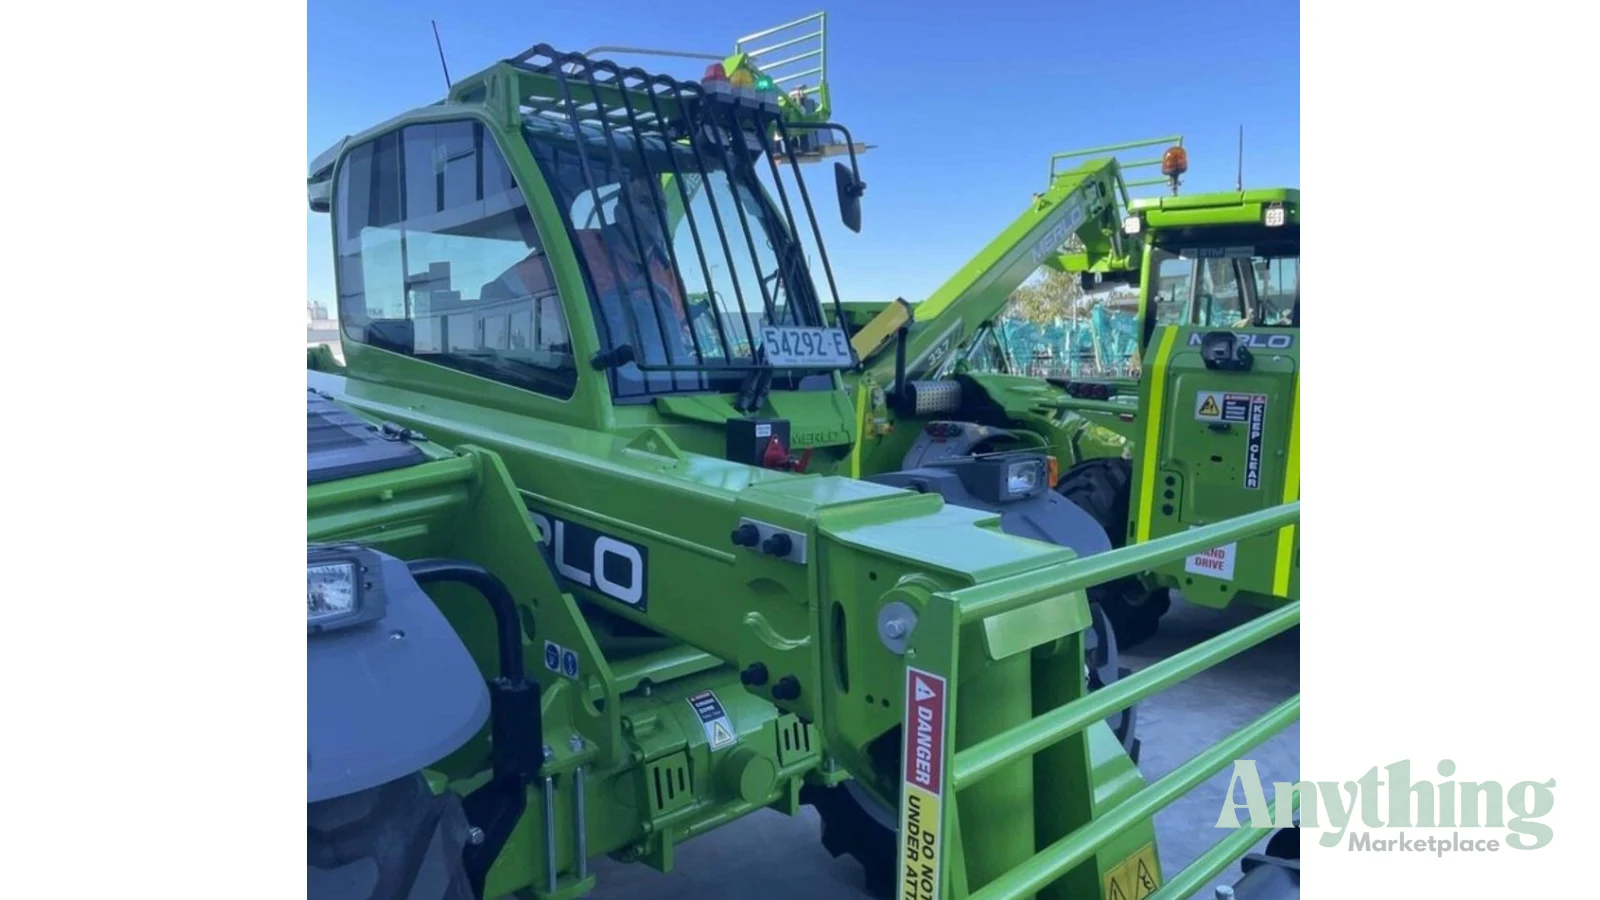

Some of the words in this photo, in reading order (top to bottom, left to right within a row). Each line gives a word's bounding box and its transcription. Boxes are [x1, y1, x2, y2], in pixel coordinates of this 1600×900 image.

[1189, 332, 1292, 349] MRLO
[1251, 404, 1263, 440] KEEP
[1247, 444, 1259, 488] CLEAR
[1195, 556, 1225, 571] DRIVE
[915, 704, 933, 785] DANGER
[907, 794, 921, 862] UNDER
[922, 829, 935, 860] DO
[905, 864, 919, 900] ATT
[920, 863, 934, 900] NOT
